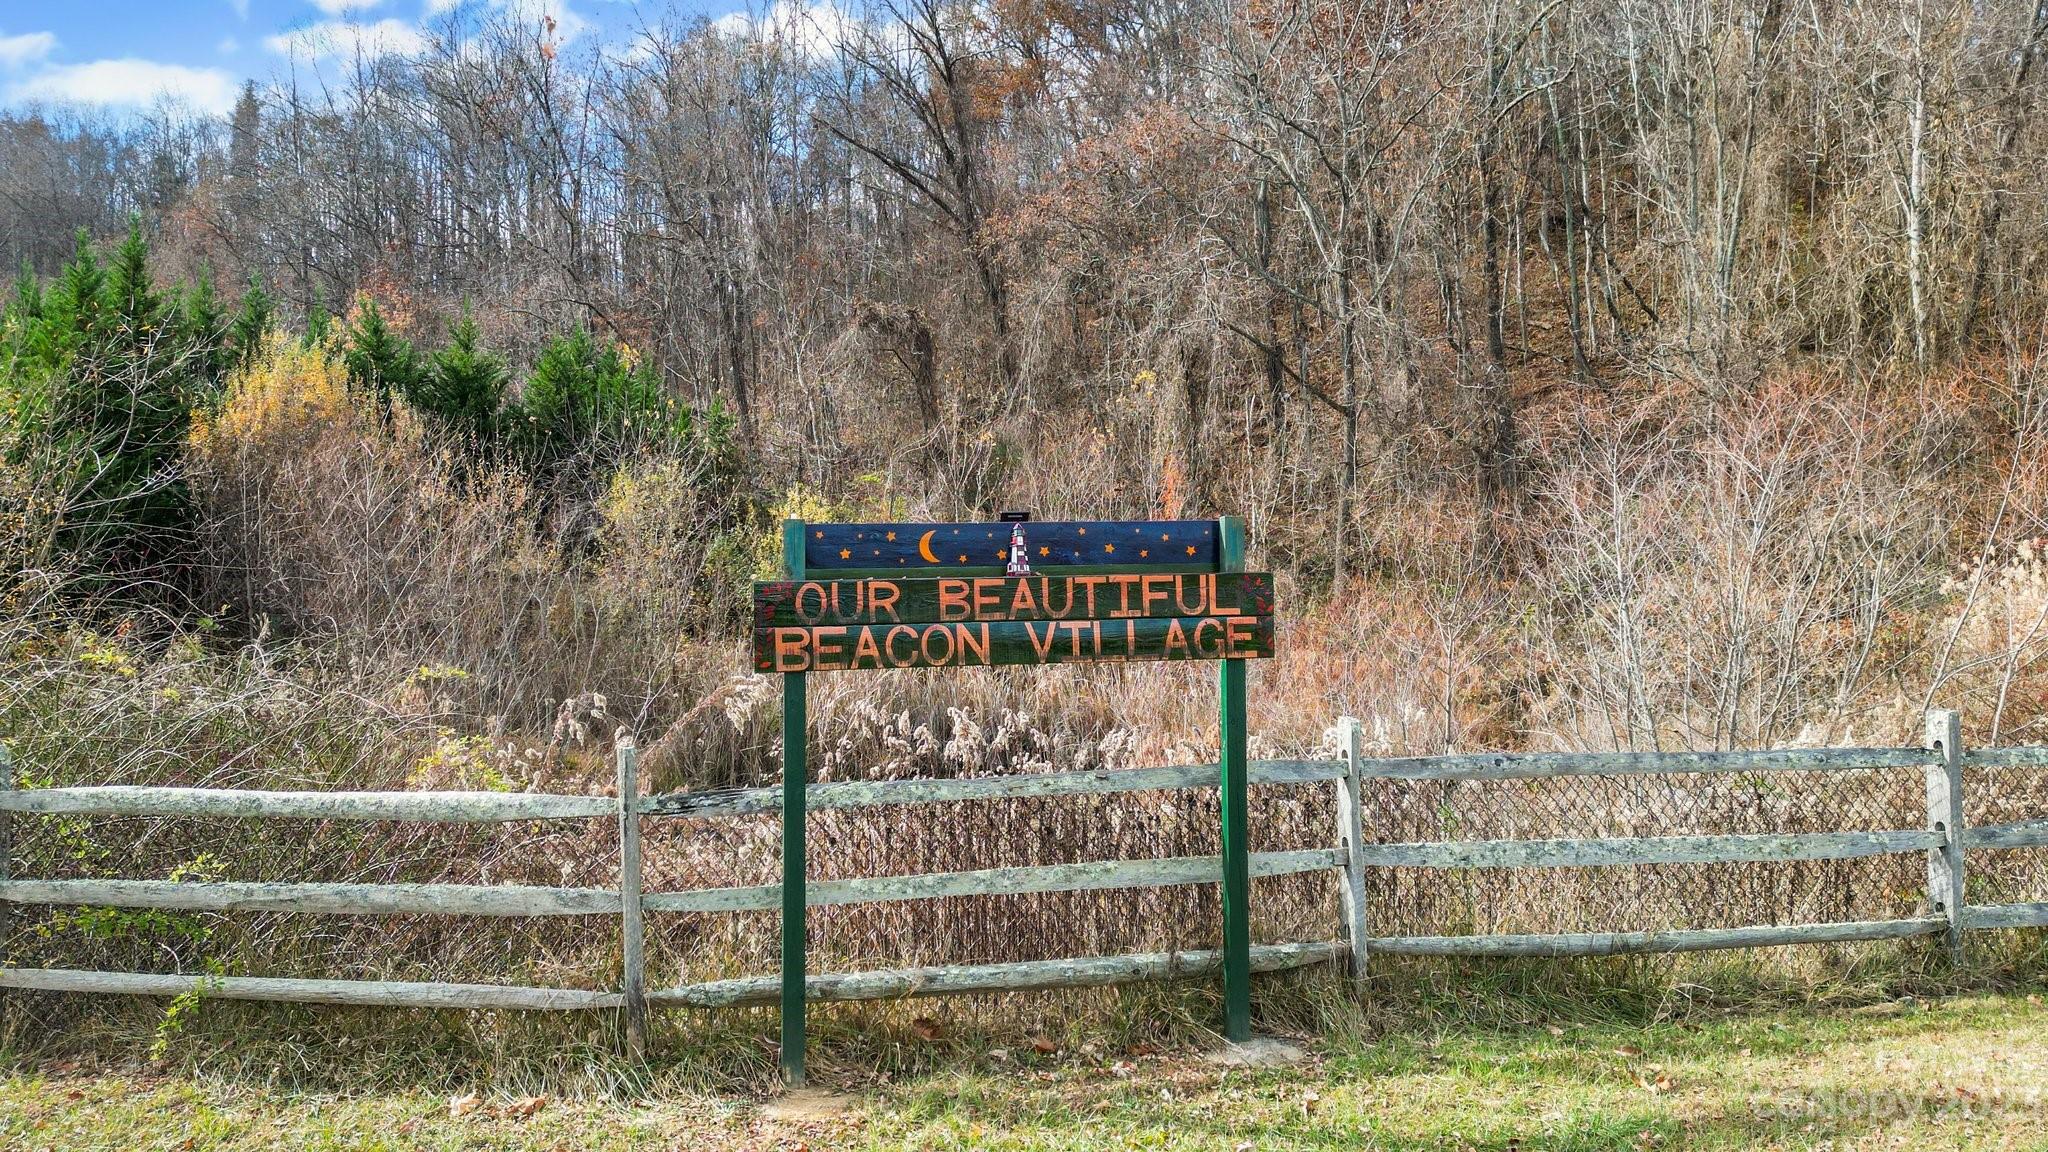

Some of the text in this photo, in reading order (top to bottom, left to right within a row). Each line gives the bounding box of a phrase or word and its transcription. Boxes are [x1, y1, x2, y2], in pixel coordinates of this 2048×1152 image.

[795, 574, 1241, 624] OUR BEAUTIFUL
[775, 617, 1258, 672] BEACON VILLAGE
